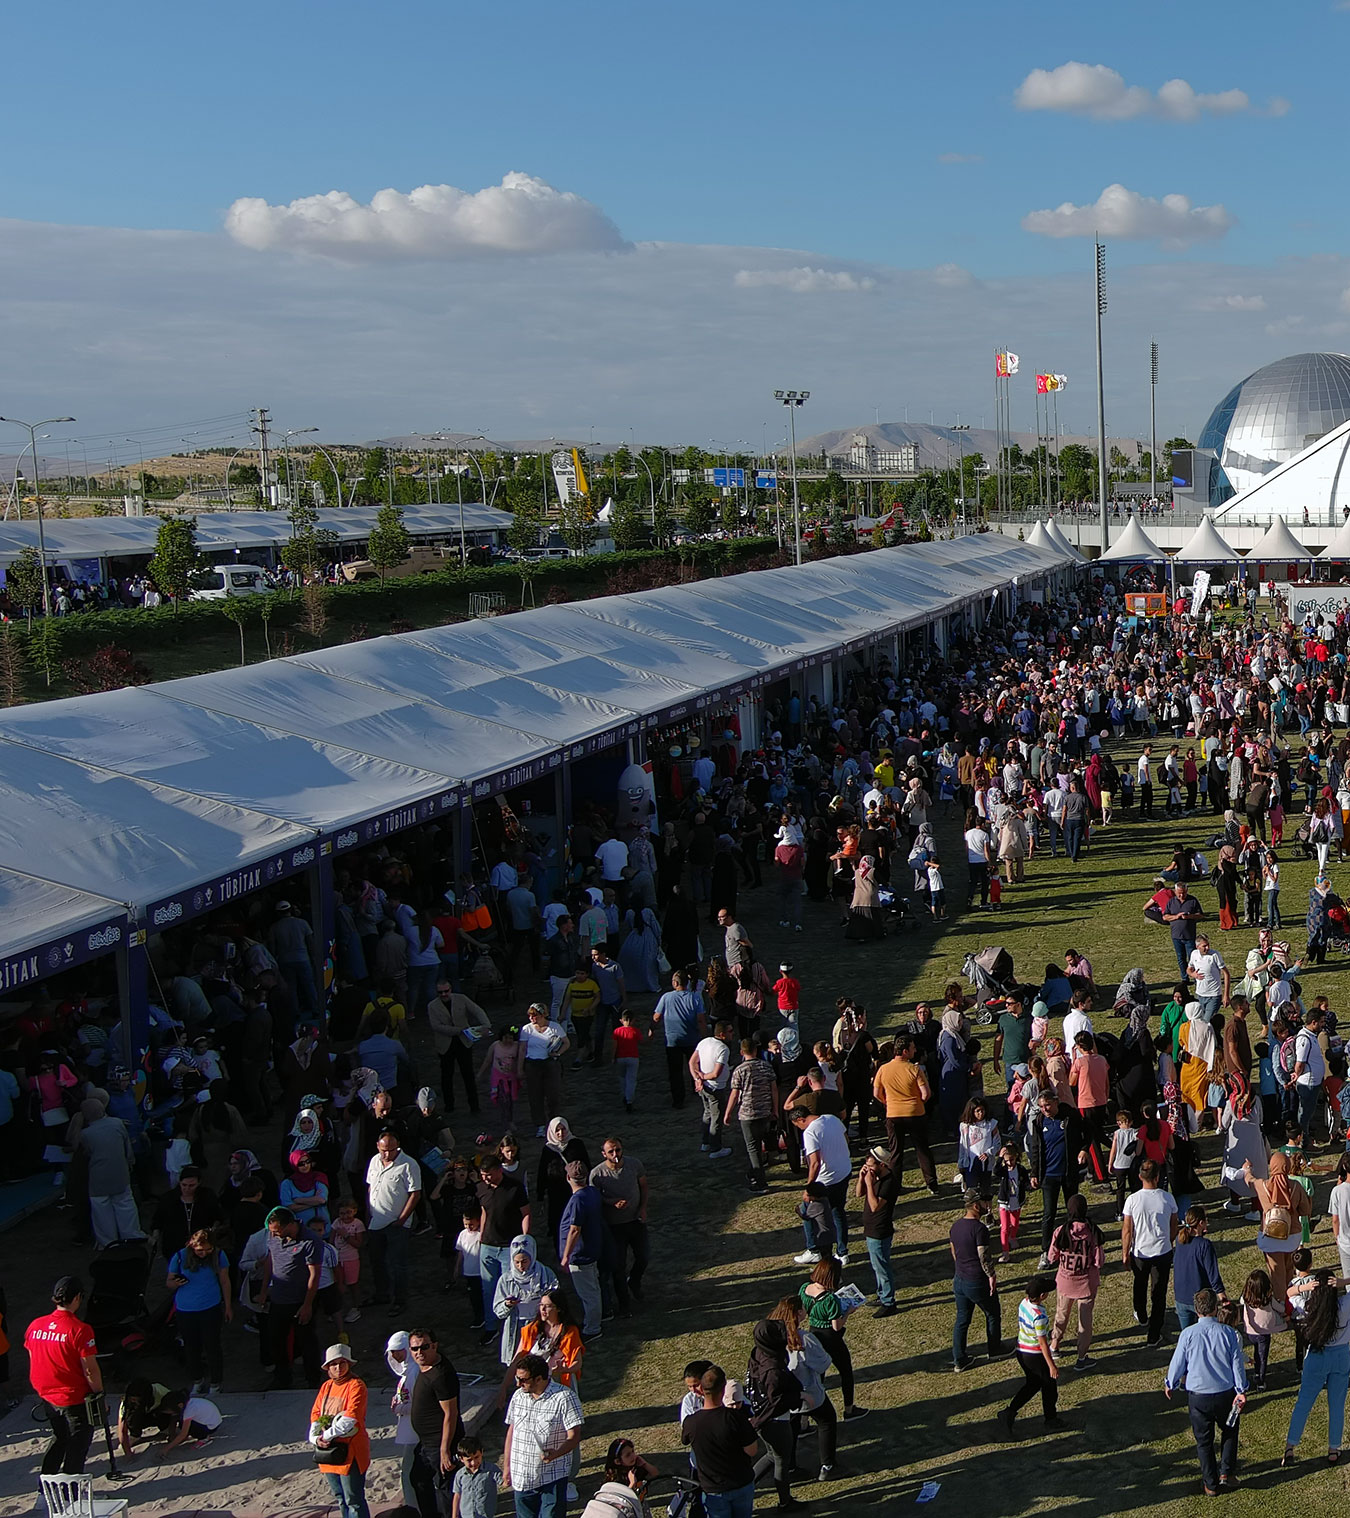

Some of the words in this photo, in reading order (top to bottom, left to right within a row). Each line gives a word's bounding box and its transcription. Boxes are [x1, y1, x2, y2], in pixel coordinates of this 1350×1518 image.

[385, 807, 417, 834] TÜBİTAK
[220, 868, 261, 902] TÜBİTAK
[32, 1329, 67, 1343] TÜBİTAK
